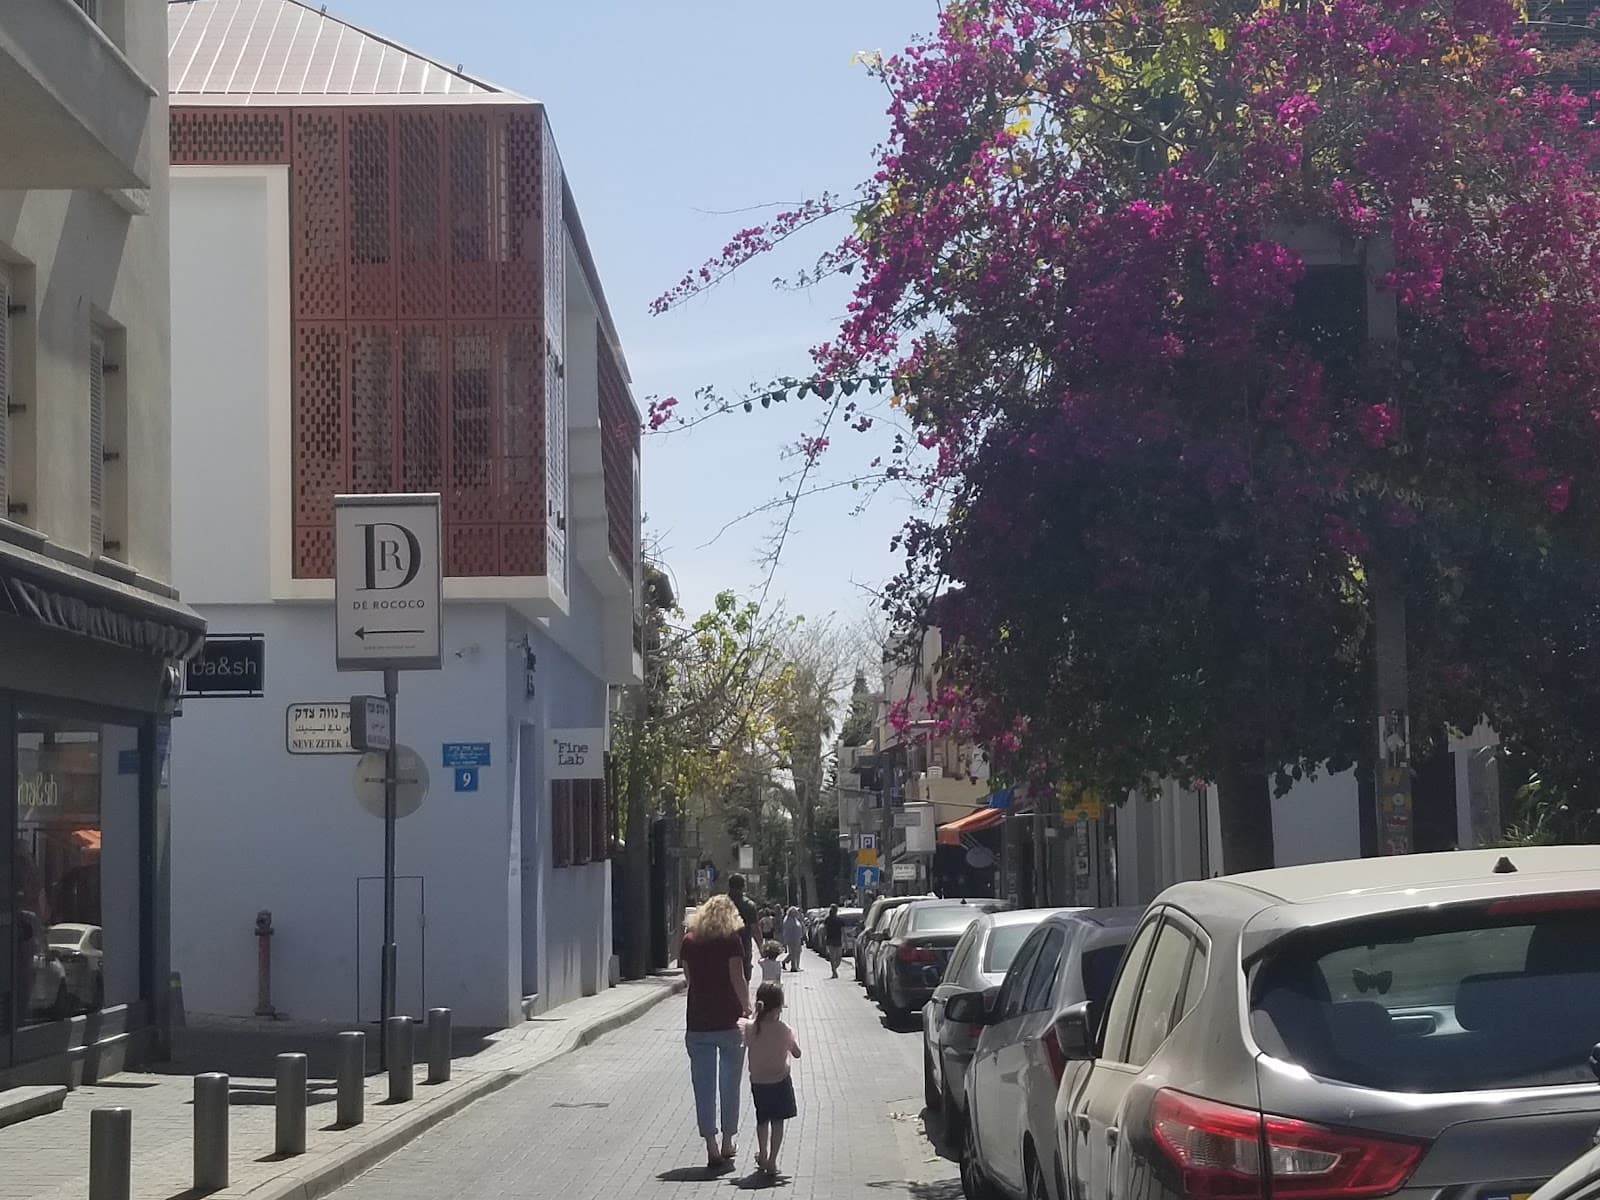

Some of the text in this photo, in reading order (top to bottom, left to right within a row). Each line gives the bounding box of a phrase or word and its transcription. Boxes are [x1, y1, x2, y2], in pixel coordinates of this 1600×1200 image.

[353, 599, 425, 610] DE ROCOCO
[295, 708, 315, 721] צדק
[319, 707, 338, 719] נווה
[558, 743, 588, 753] Fine
[558, 755, 585, 765] Lab
[463, 772, 471, 787] 9
